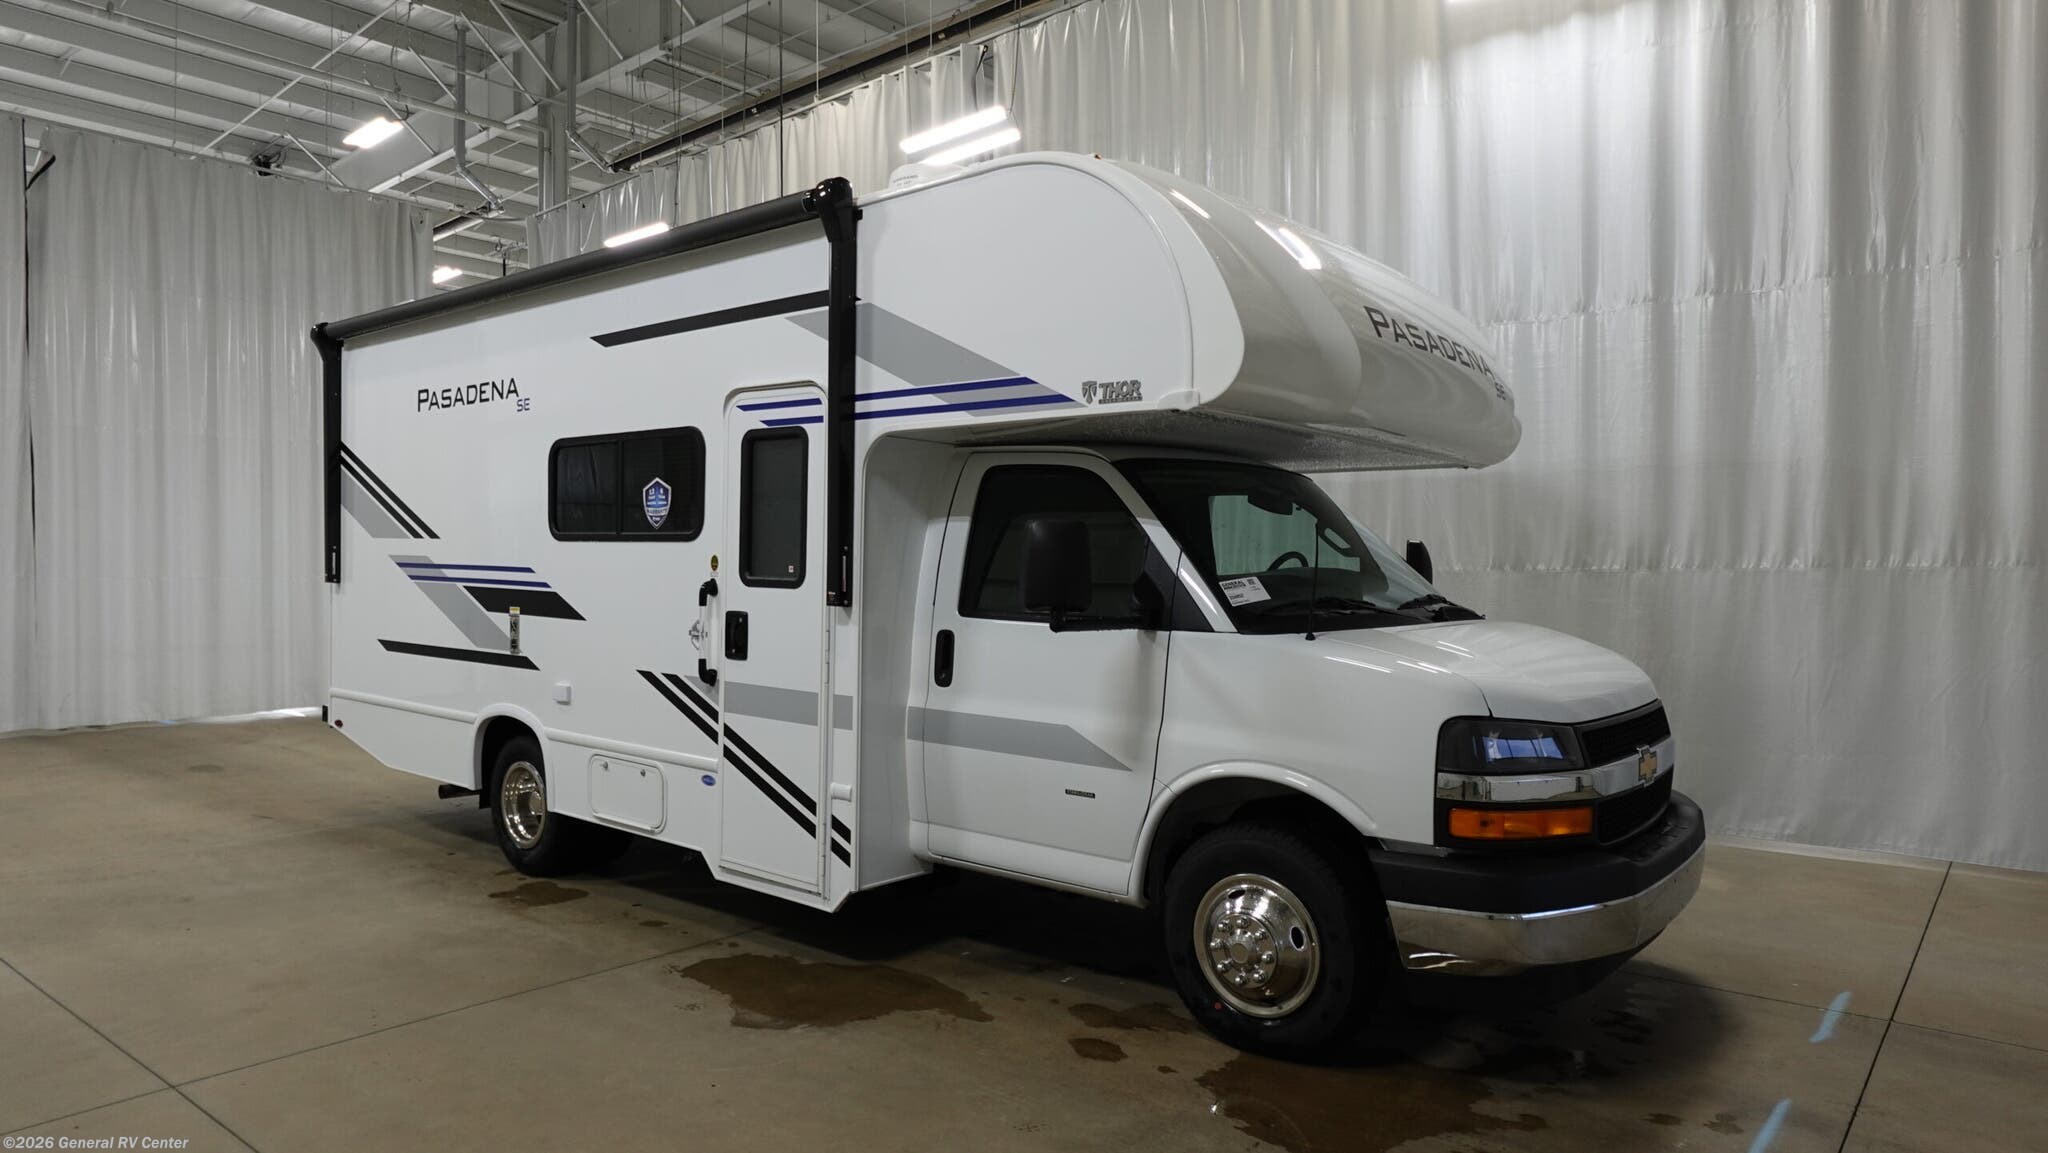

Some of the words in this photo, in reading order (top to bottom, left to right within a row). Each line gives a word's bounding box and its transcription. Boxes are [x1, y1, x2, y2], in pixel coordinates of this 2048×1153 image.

[1364, 305, 1494, 379] PASADENA
[417, 377, 519, 412] PASADENA
[1099, 379, 1142, 398] THOR
[516, 398, 531, 412] SE
